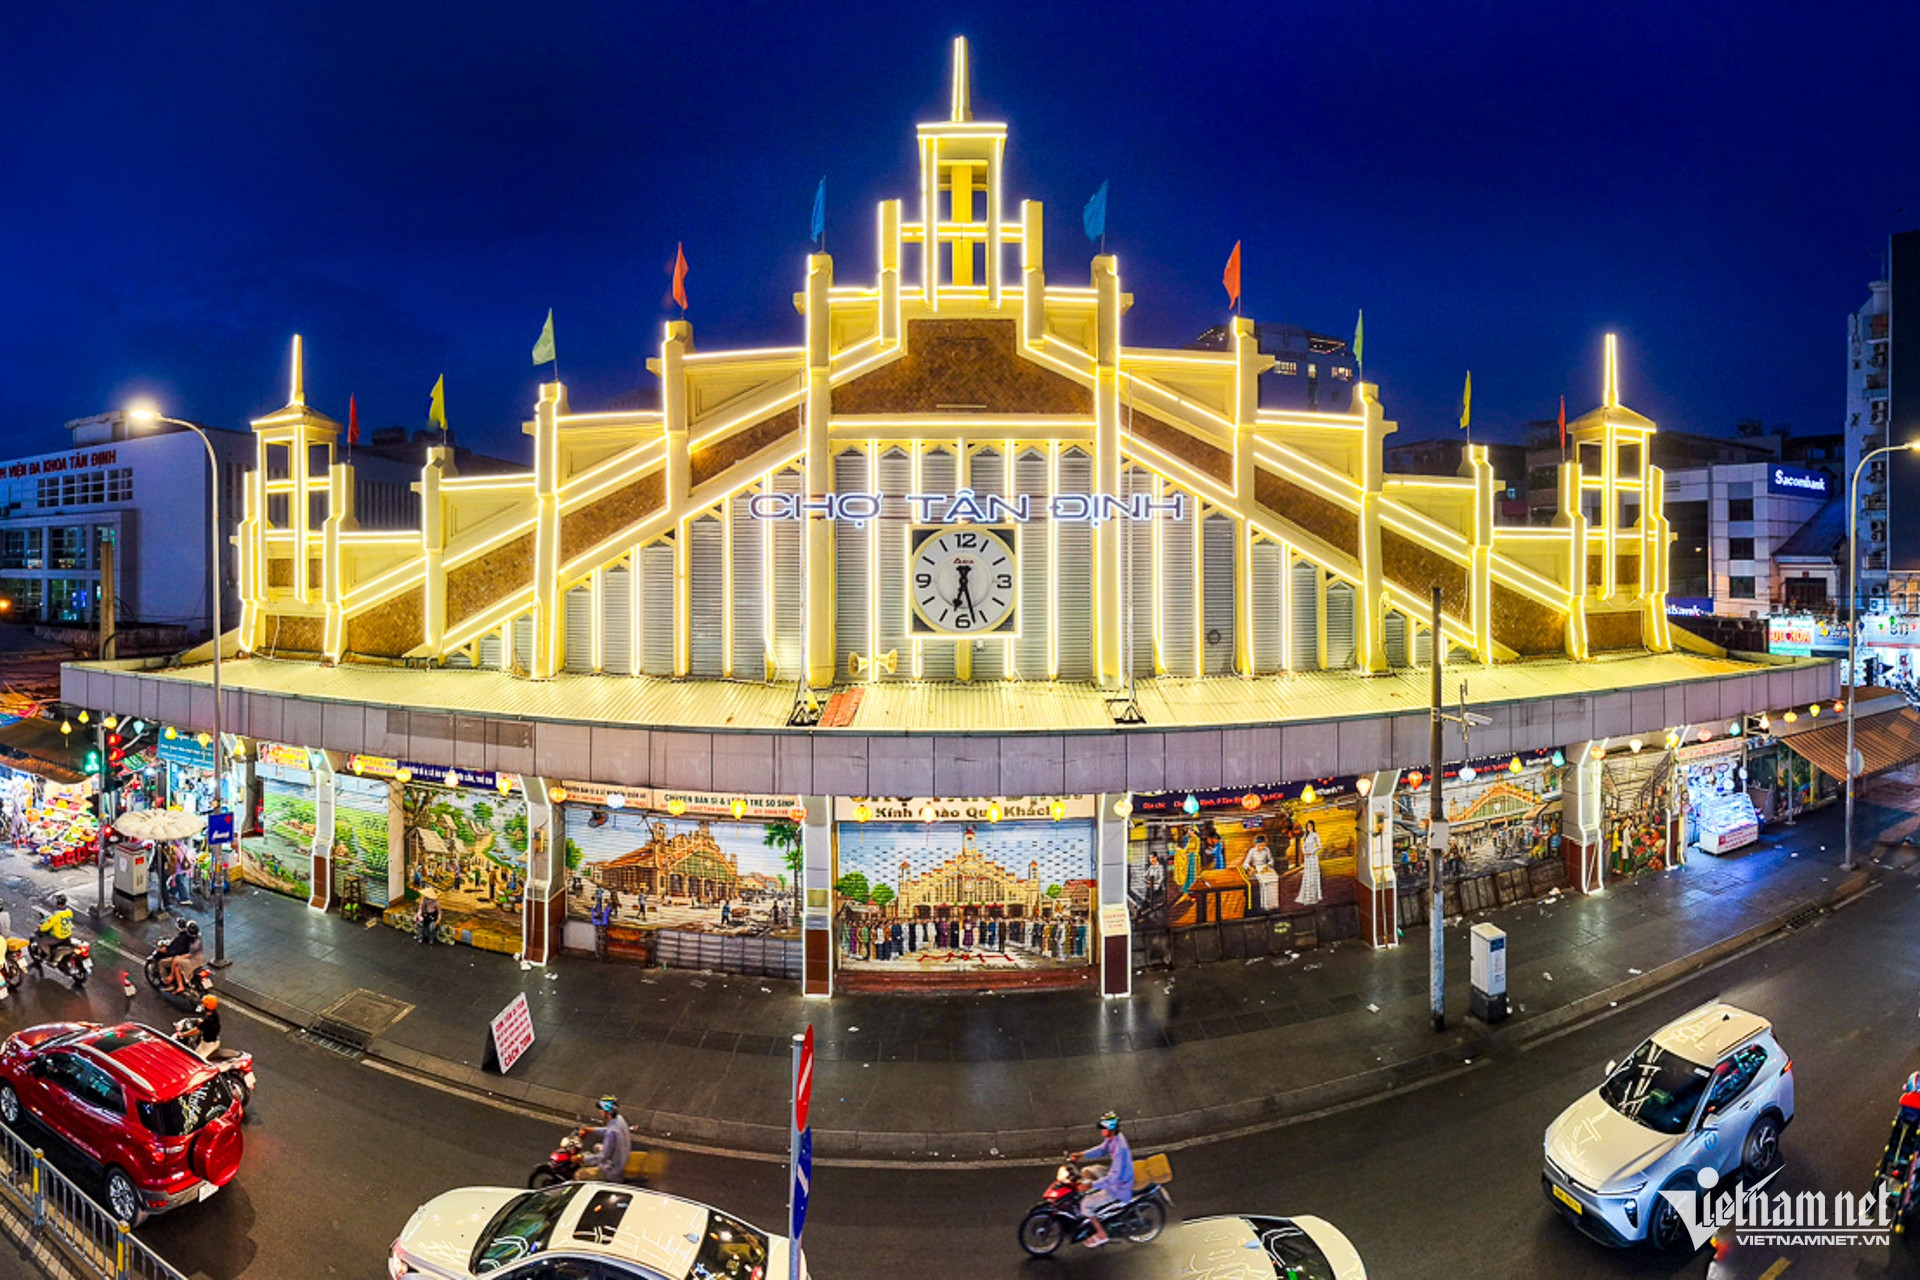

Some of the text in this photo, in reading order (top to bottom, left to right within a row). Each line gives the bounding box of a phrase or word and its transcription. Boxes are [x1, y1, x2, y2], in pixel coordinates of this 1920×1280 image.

[9, 461, 27, 478] VIỆN
[29, 462, 40, 475] ĐA
[43, 457, 67, 473] KHOA
[70, 452, 88, 469] TÂN
[91, 449, 117, 468] ĐỊNH
[1775, 470, 1826, 491] Sacombank
[749, 488, 1185, 529] CHỢ TÂN ĐỊNH
[954, 533, 977, 548] 12
[915, 573, 1012, 588] 9 3
[955, 614, 971, 628] 6
[875, 807, 912, 818] Kính
